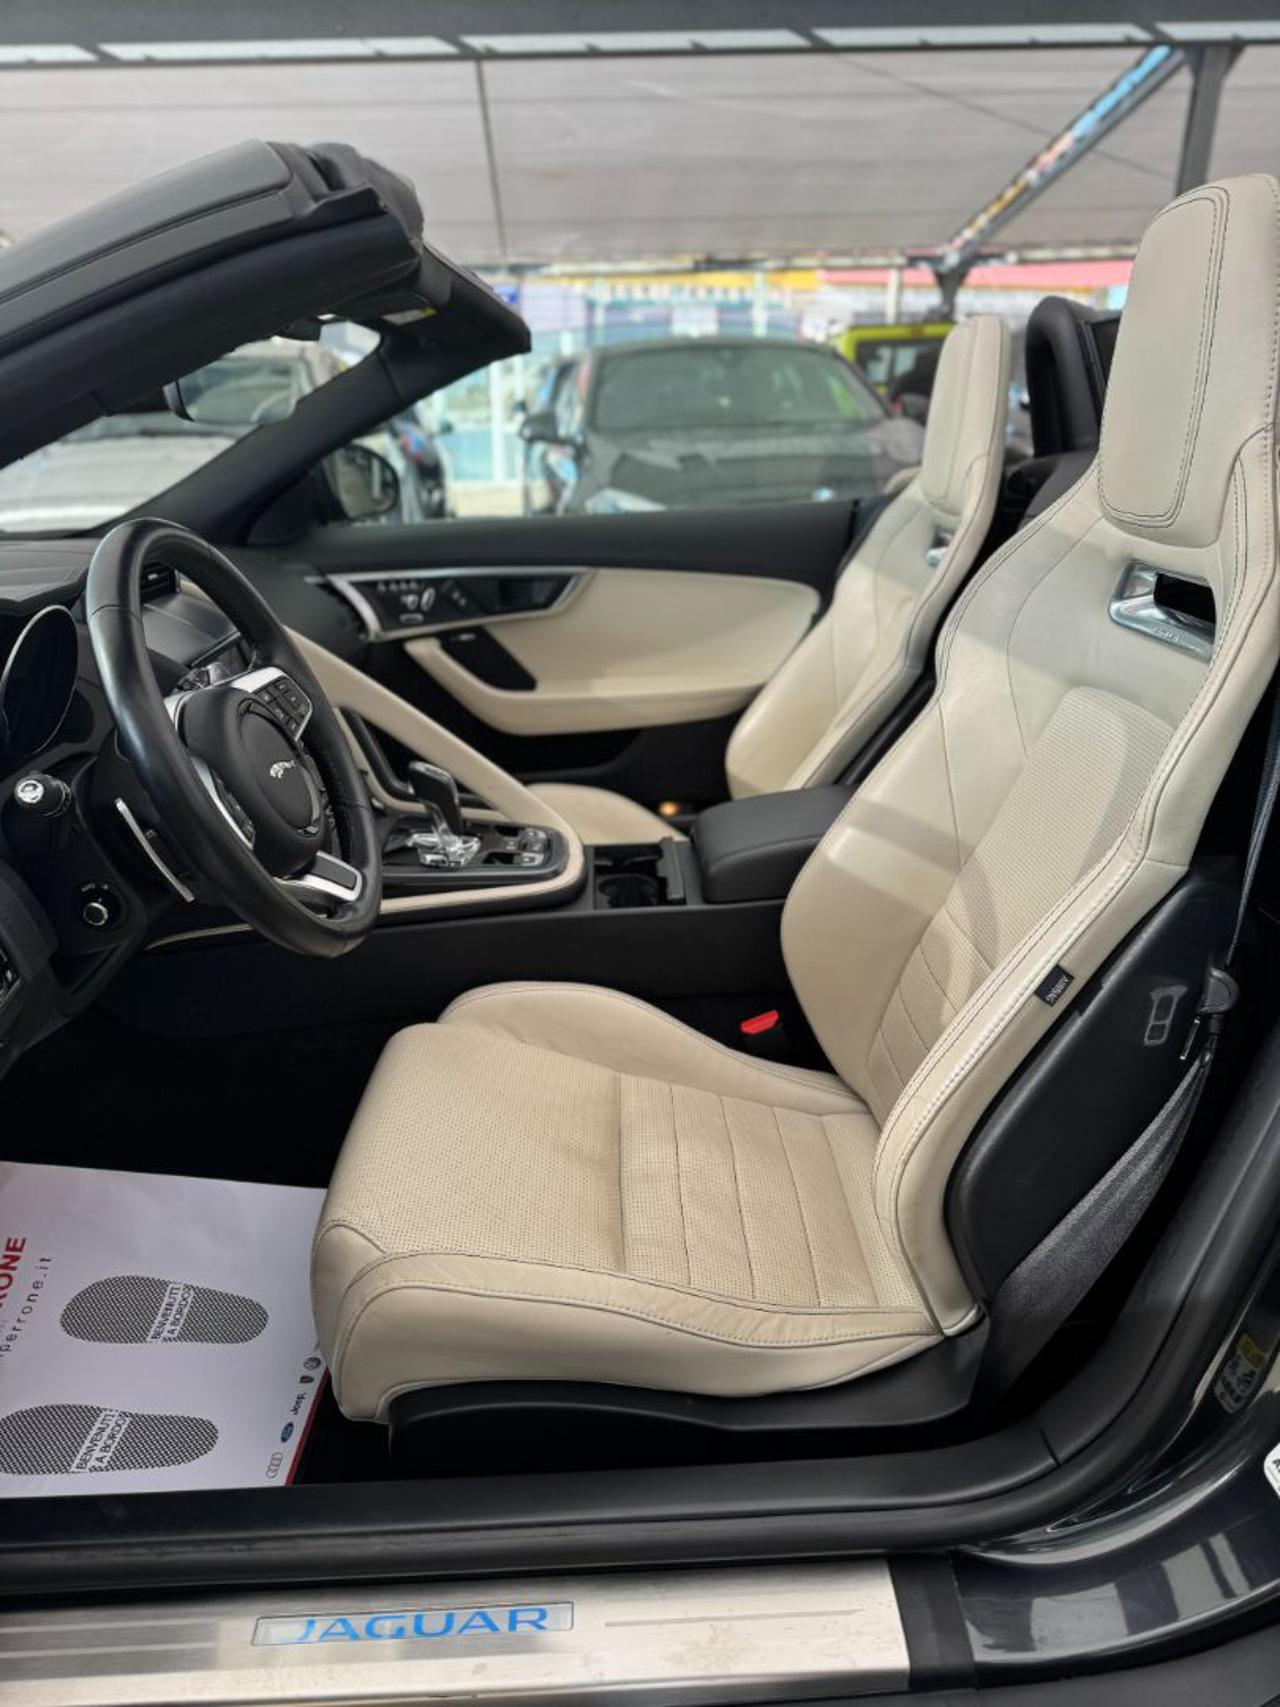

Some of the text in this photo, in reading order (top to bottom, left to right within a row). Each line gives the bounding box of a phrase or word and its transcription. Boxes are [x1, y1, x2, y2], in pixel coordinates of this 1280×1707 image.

[0, 1237, 26, 1308] ONE
[0, 1257, 51, 1357] perrone.it
[151, 1286, 181, 1340] BENVENUTI
[75, 1414, 116, 1469] BENVENUTI
[280, 1606, 549, 1644] JAGUAR
